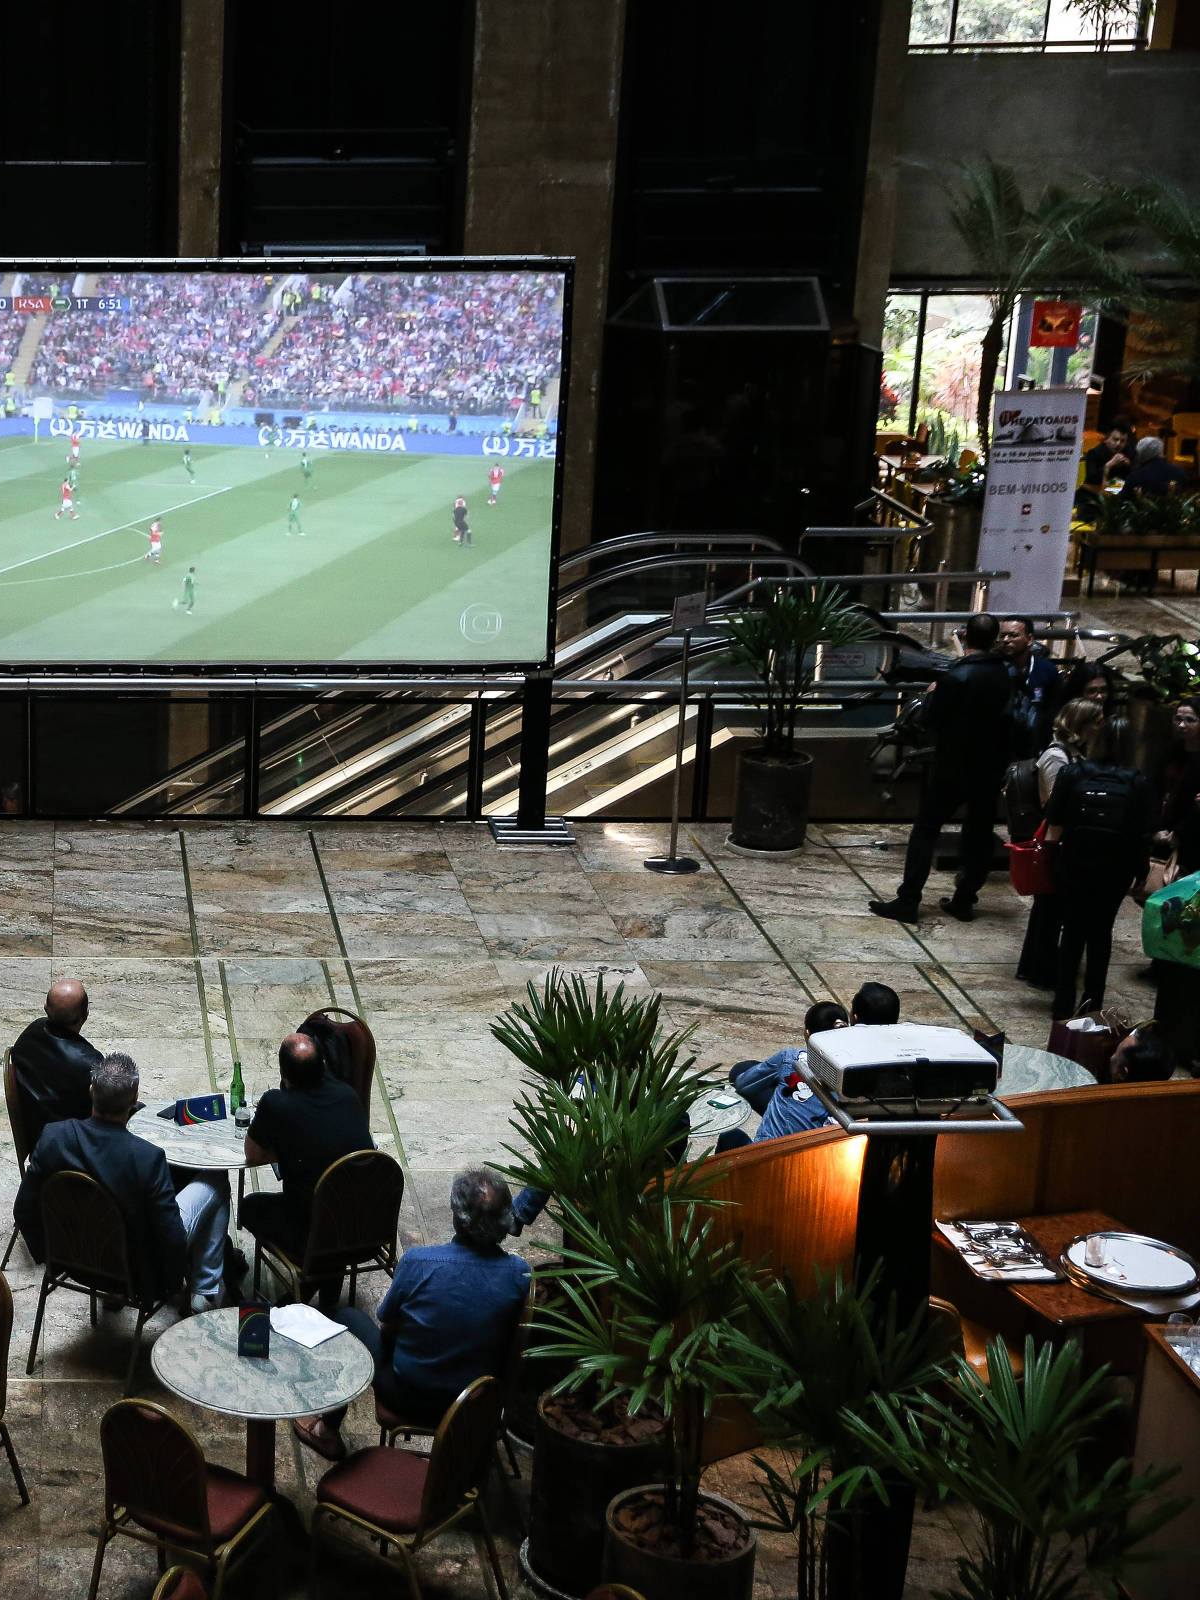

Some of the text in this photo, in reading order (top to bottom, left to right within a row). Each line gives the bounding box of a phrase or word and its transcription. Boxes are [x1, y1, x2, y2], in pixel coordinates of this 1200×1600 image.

[18, 299, 44, 309] RSA
[76, 299, 89, 309] 1T
[1011, 415, 1079, 426] HEPATOAIDS
[117, 421, 190, 441] WANDA
[329, 431, 407, 451] WANDA
[989, 482, 1068, 496] BEM-VINDOS
